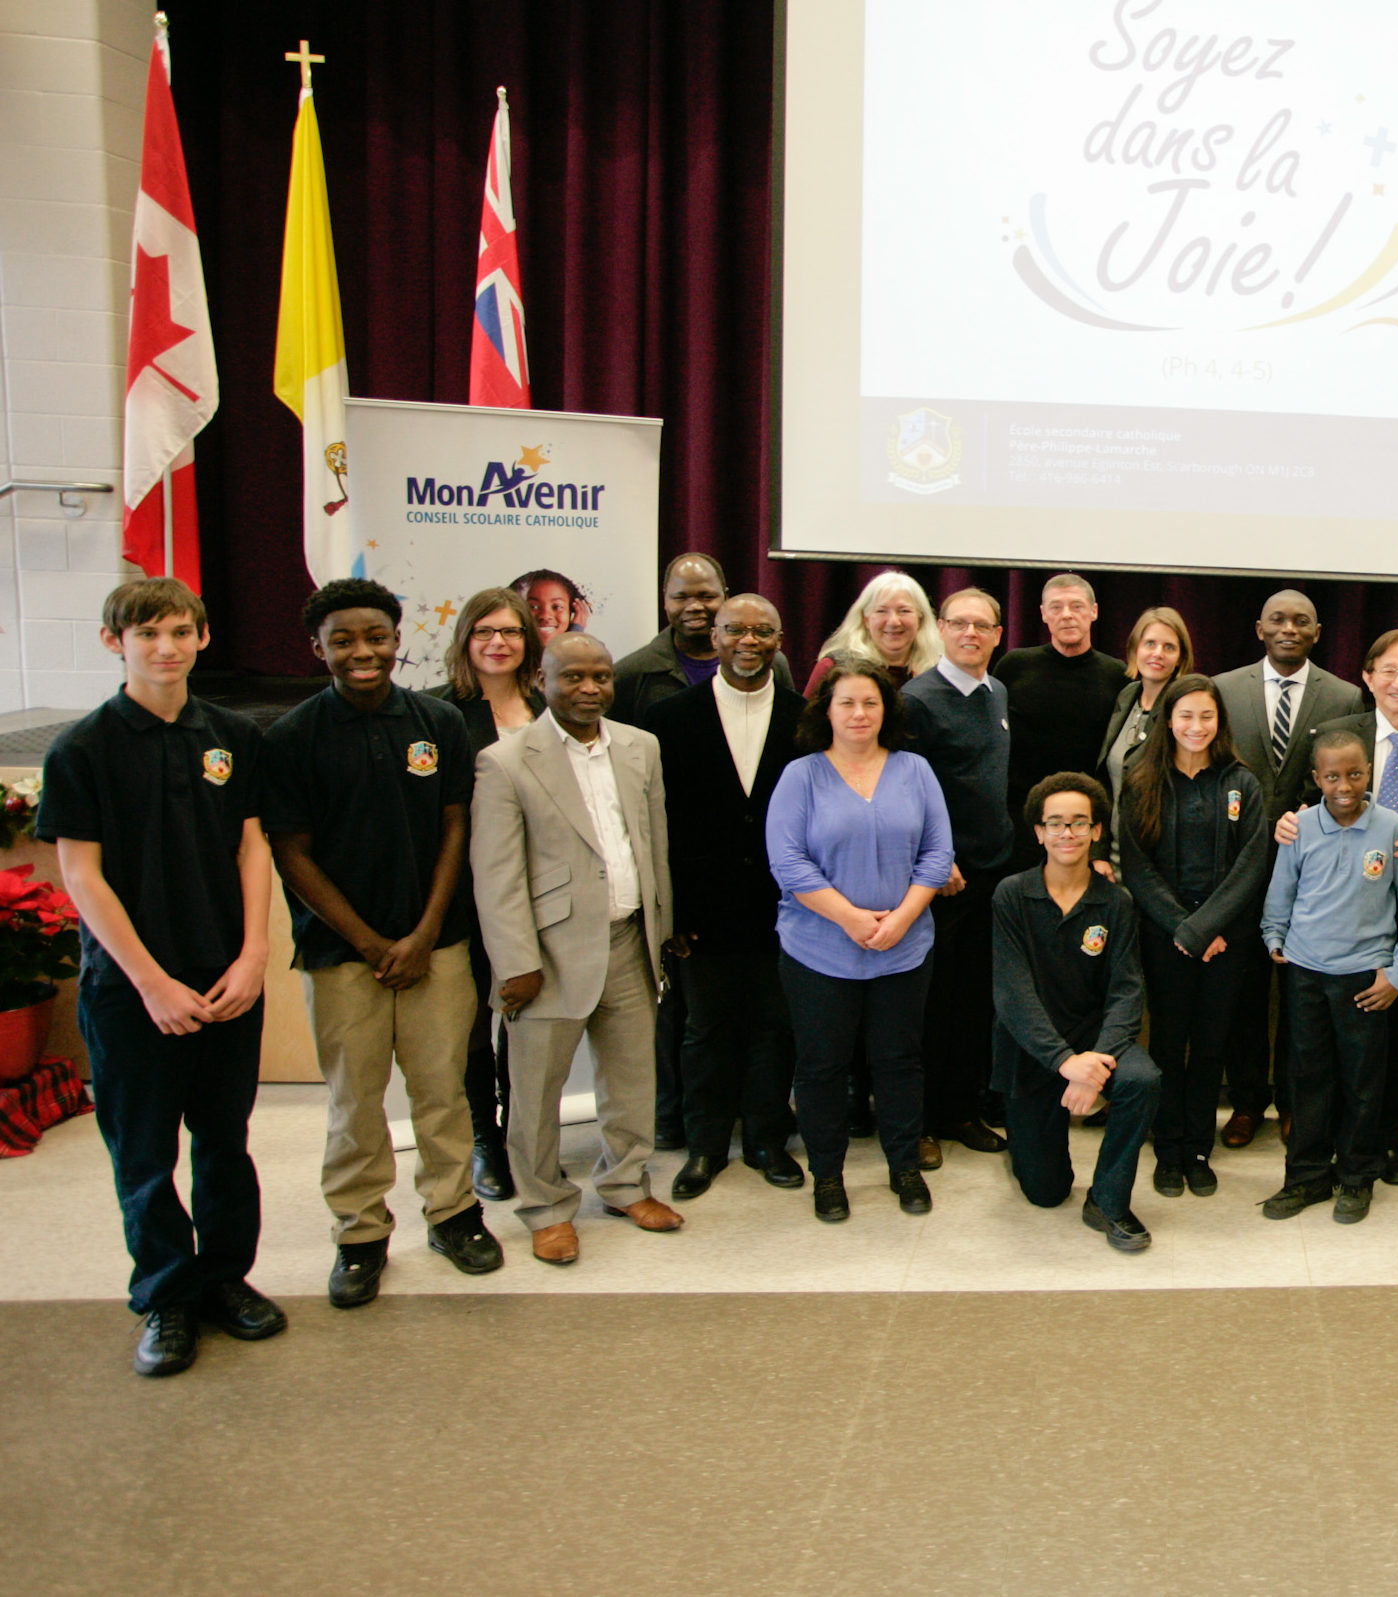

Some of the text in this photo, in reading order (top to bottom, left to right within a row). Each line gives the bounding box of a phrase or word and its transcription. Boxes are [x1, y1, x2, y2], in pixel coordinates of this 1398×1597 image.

[1089, 0, 1295, 114] Soyez
[1083, 83, 1301, 198] dans la
[1161, 355, 1198, 382] (Ph
[1045, 425, 1113, 439] secondaire
[1115, 428, 1183, 443] catholique
[406, 460, 605, 511] MonAvenir
[406, 511, 599, 530] CONSEIL SCOLAIRE CATHOLIQUE
